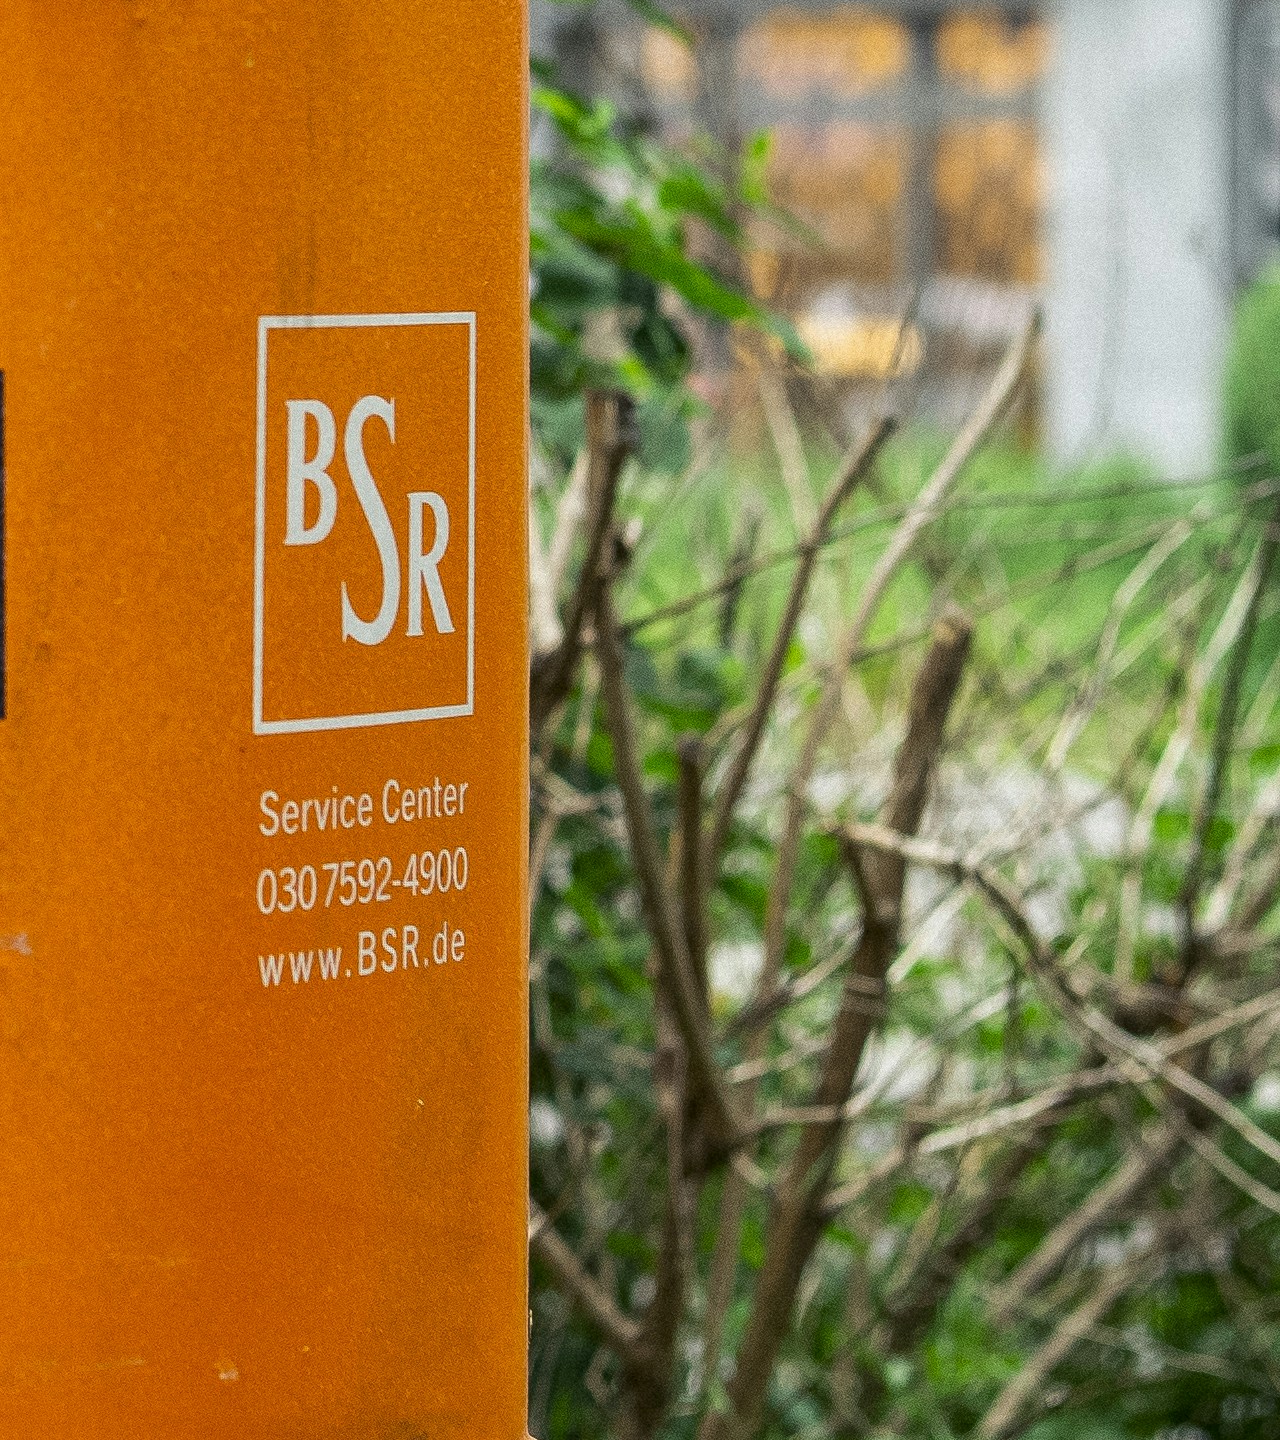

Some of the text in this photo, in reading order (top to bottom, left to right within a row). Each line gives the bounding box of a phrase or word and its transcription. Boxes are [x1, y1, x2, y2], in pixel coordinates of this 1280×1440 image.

[283, 395, 455, 646] BSR
[257, 775, 470, 837] Service Center
[257, 920, 467, 988] www.BSR.de
